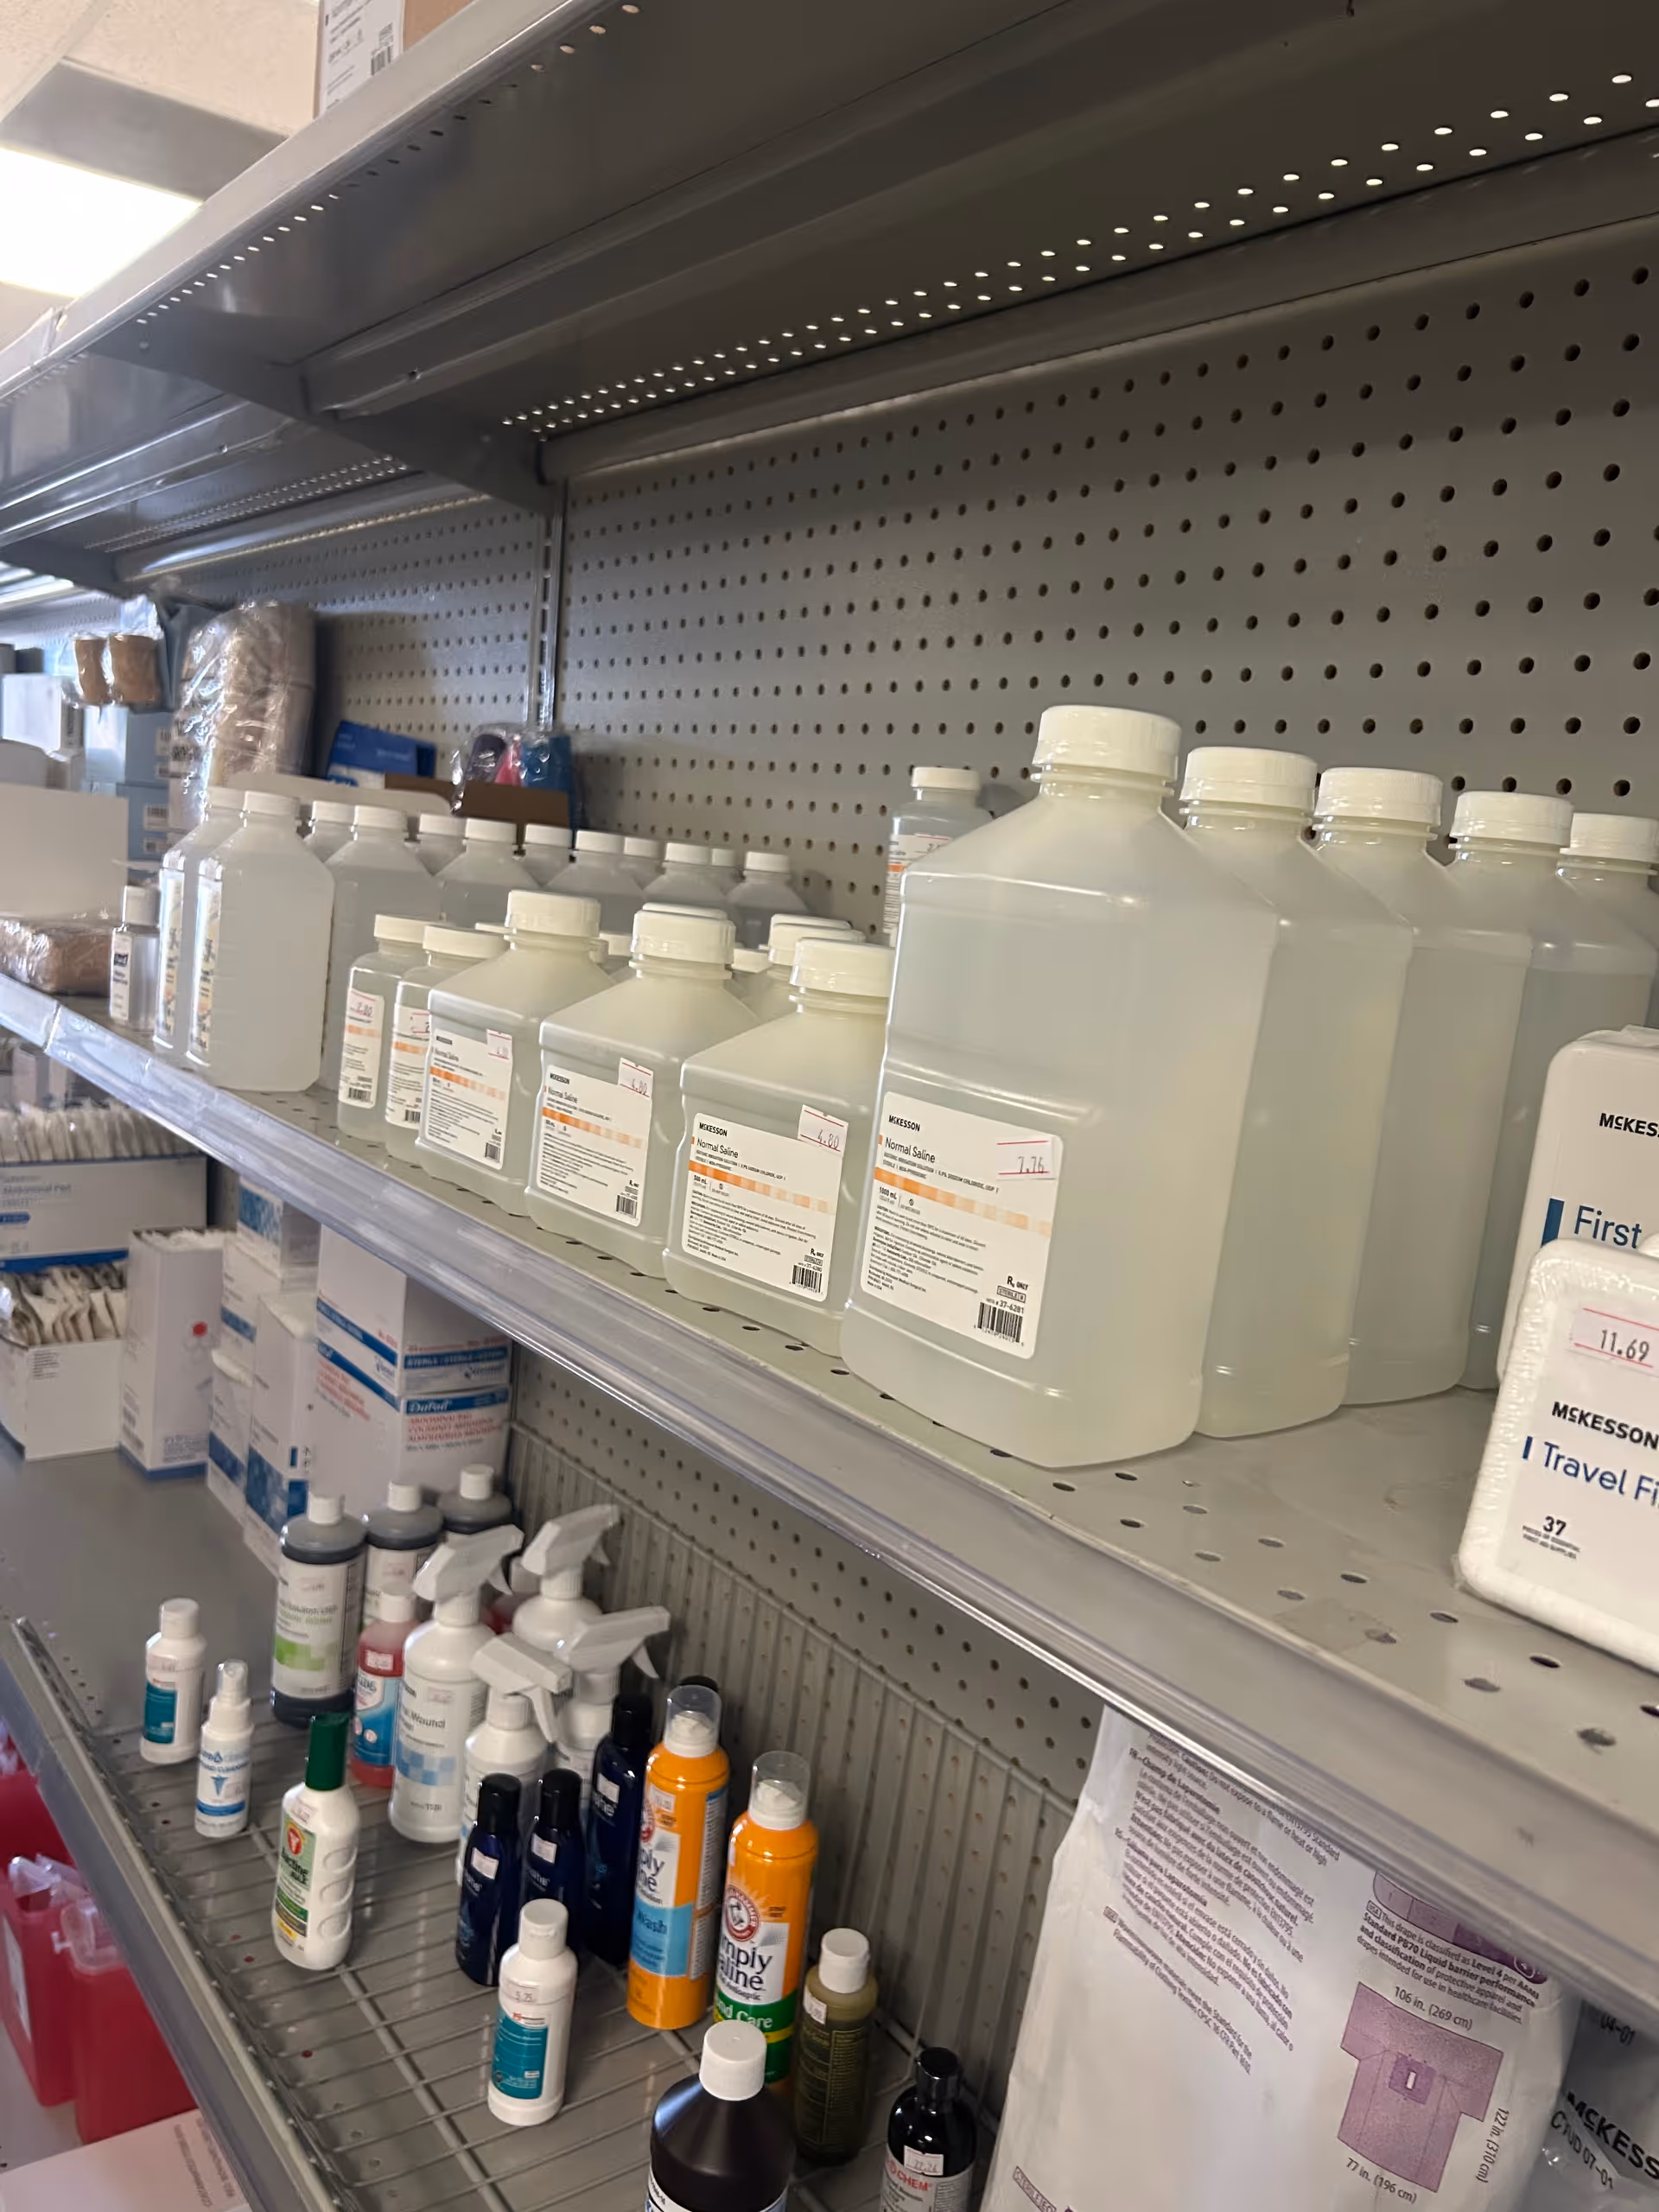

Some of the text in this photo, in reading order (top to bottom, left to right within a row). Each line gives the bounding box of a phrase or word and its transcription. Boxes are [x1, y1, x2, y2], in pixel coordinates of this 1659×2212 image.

[817, 1129, 839, 1149] 4.80
[1599, 1112, 1659, 1138] McKES
[696, 1137, 739, 1159] Normal Saline
[885, 1136, 936, 1164] Normal Saline
[888, 1191, 898, 1199] mL
[1574, 1205, 1642, 1249] First
[1599, 1329, 1650, 1363] 11.69
[1543, 1440, 1659, 1510] Travel Fi
[1543, 1516, 1567, 1536] 37
[1357, 1934, 1378, 1956] drapes
[1379, 1948, 1410, 1975] intended
[1411, 1967, 1424, 1982] for
[1423, 1976, 1437, 1988] use
[1439, 1981, 1446, 1991] in
[1446, 1985, 1488, 2010] healthcare
[1360, 1924, 1522, 2012] and classification of protective apparel and
[1363, 1911, 1535, 2008] Standard PB70 Liquid barrier performance
[1382, 1912, 1395, 1929] This
[1396, 1921, 1417, 1942] drape
[1426, 1936, 1461, 1961] classified
[1461, 1955, 1471, 1965] as
[1471, 1956, 1496, 1975] Level
[1503, 1972, 1517, 1988] per
[736, 2010, 773, 2029] Care
[1394, 1986, 1473, 2031] 106 in. (269 cm)
[1475, 2107, 1510, 2184] 122 in. (310 cm)
[1346, 2158, 1417, 2204] 77 in. (196 cm)
